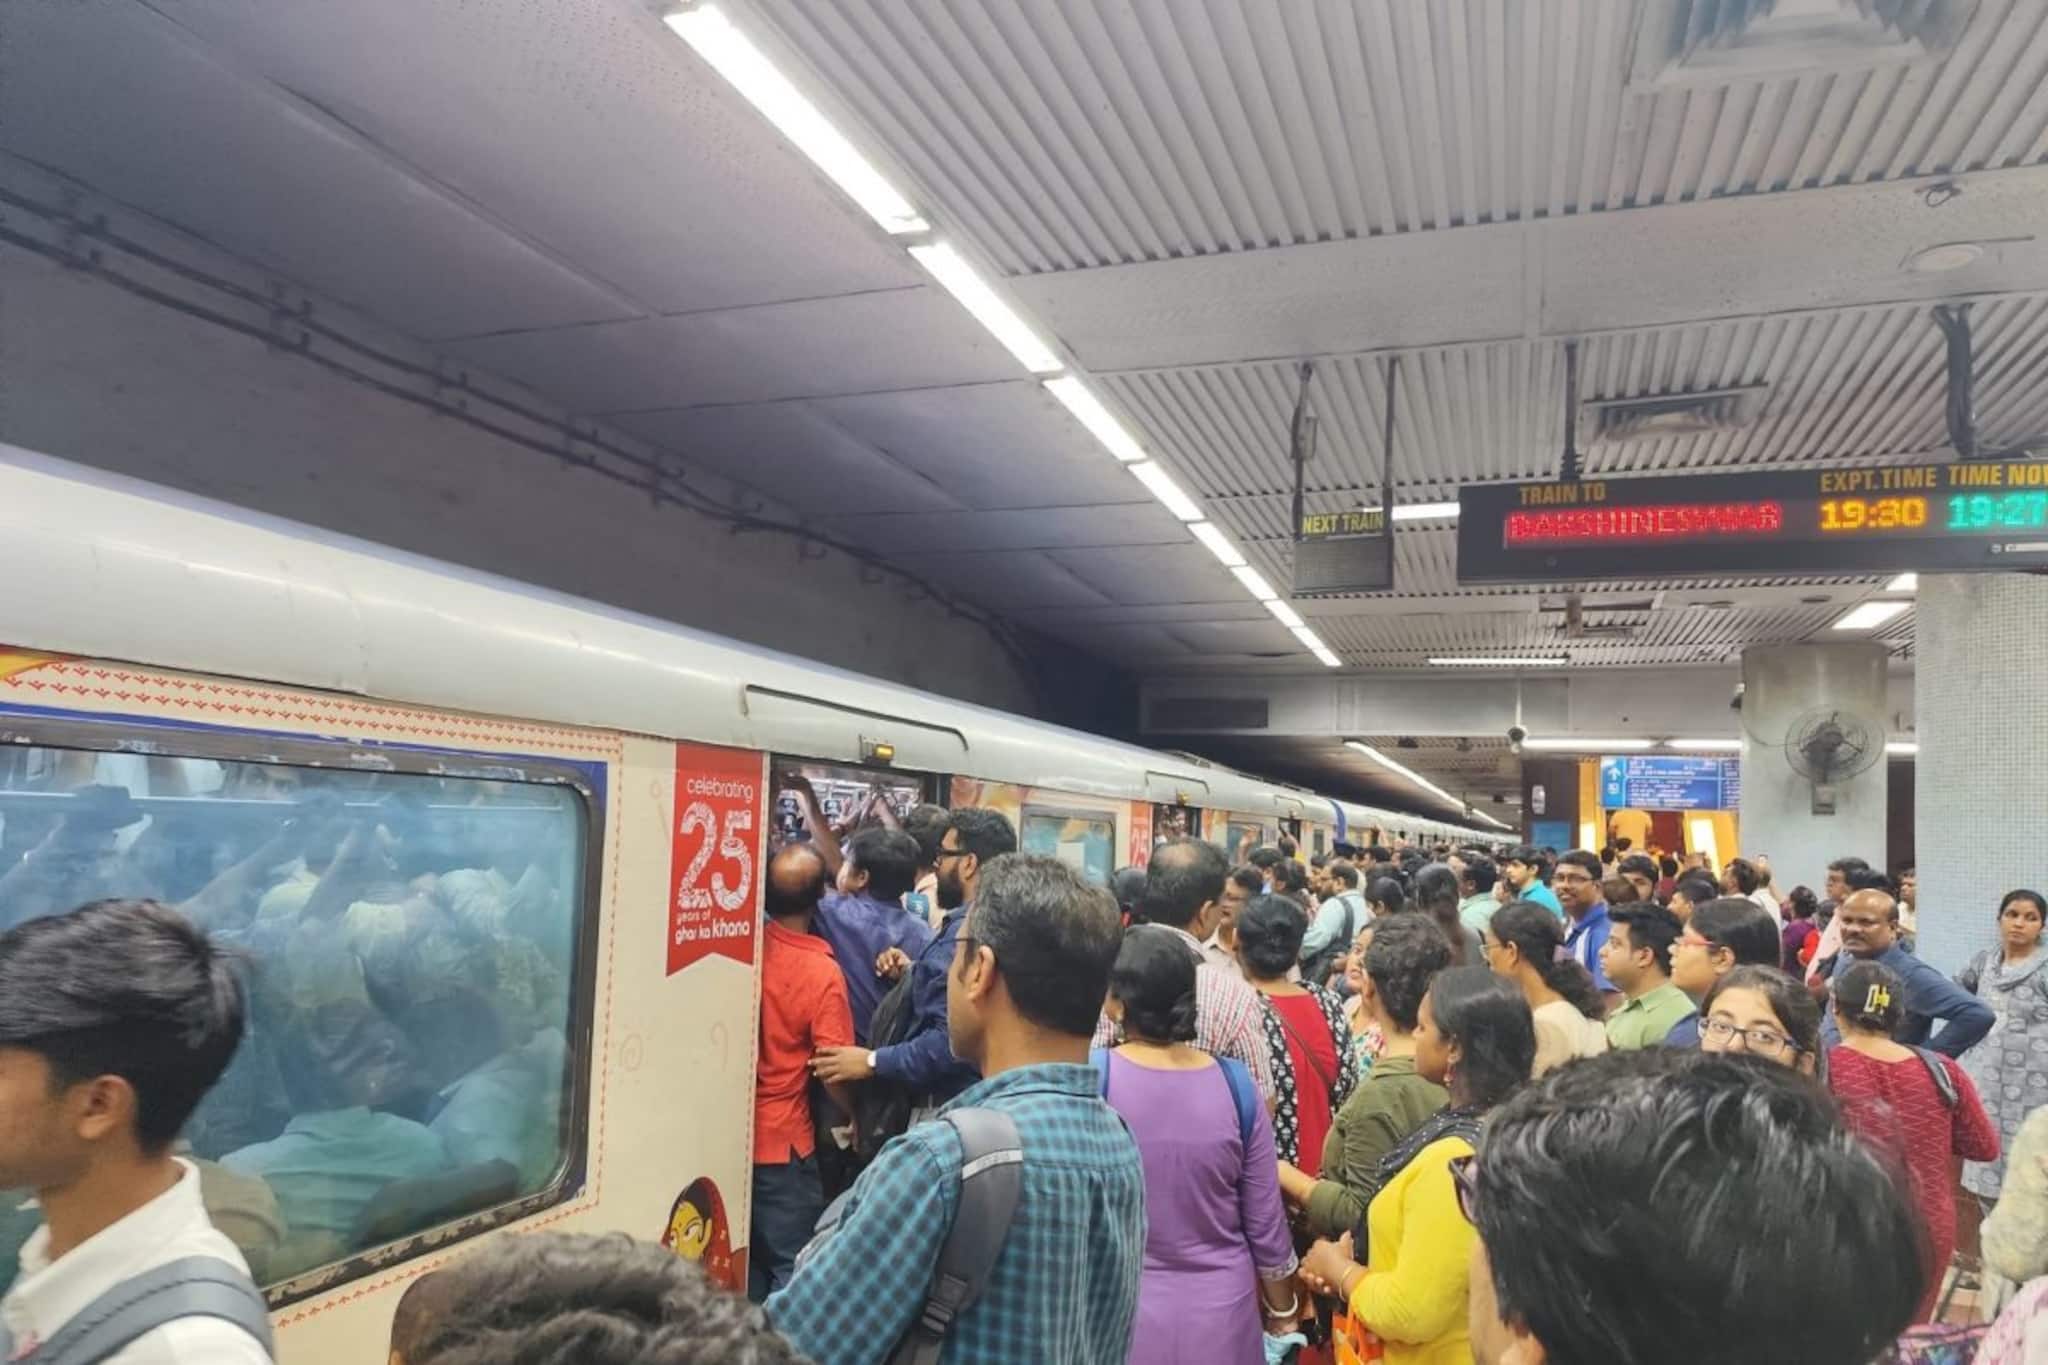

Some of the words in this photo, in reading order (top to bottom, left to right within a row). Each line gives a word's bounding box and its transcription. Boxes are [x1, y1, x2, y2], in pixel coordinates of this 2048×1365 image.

[1881, 467, 1937, 489] TIME
[1949, 464, 2002, 486] TIME
[2008, 463, 2048, 485] NO
[1519, 483, 1577, 504] TRAIN
[1583, 481, 1606, 501] TO
[1303, 513, 1338, 534] NEXT
[1342, 511, 1384, 532] TRAIN
[1820, 496, 1927, 529] 19:30
[1948, 492, 2048, 528] 19:27
[687, 777, 753, 803] celebrating
[677, 801, 753, 912] 25
[675, 924, 697, 945] ghar
[712, 917, 750, 938] khana
